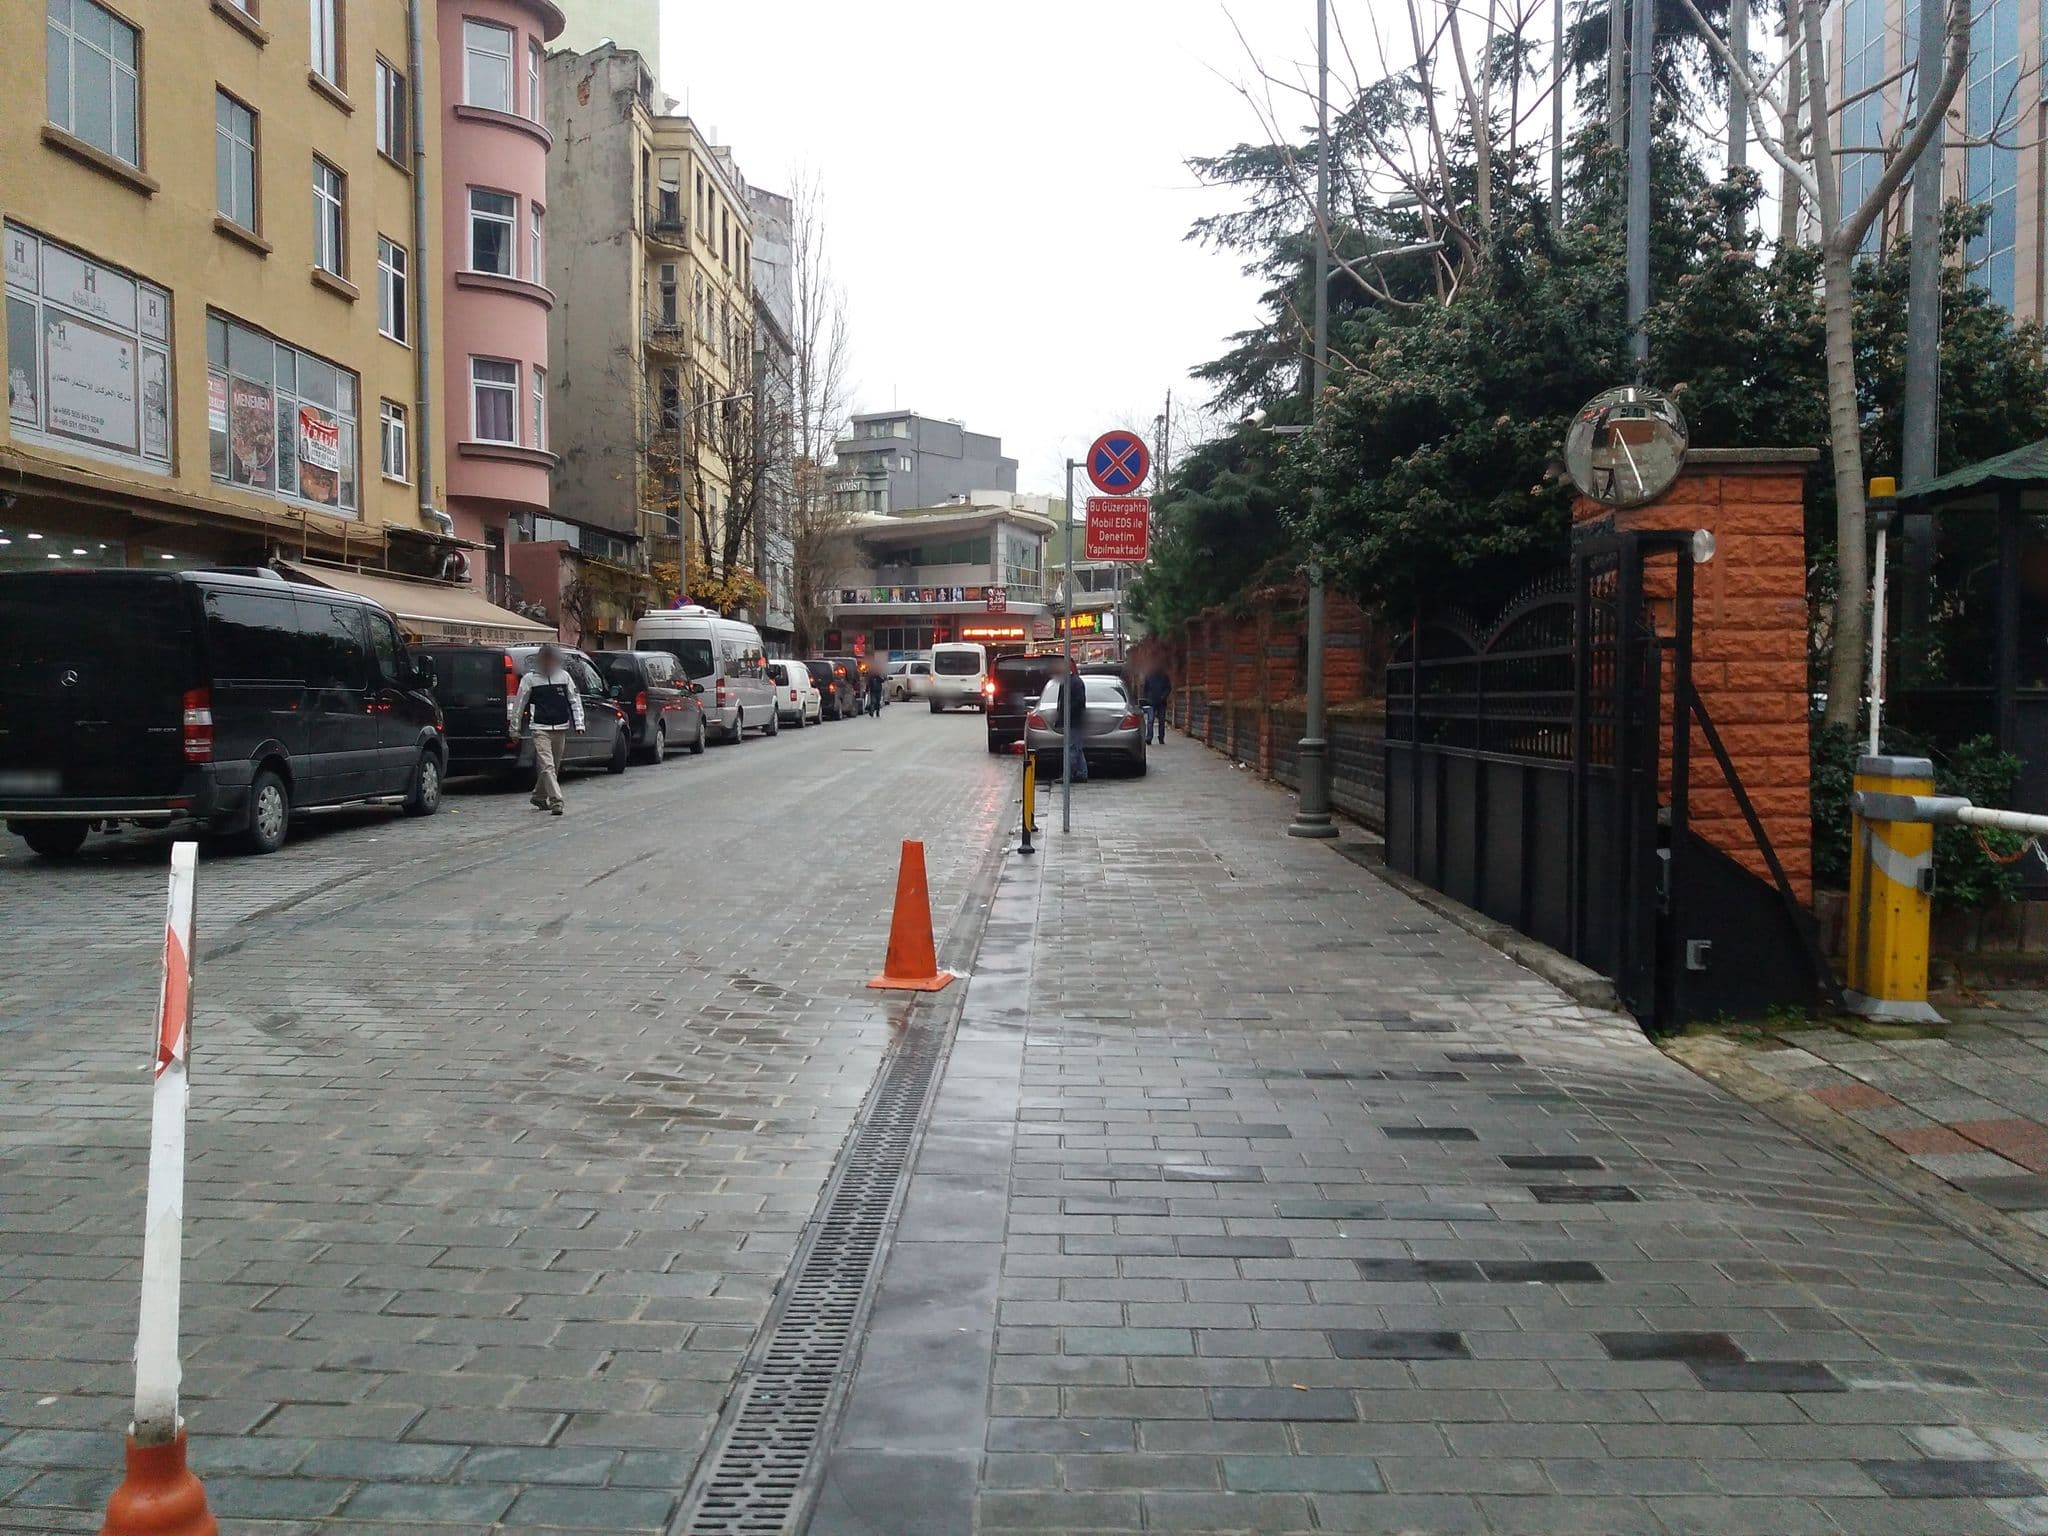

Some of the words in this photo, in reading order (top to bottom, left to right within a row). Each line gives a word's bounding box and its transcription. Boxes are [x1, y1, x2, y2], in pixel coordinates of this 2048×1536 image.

[14, 239, 25, 263] H
[83, 264, 97, 293] H
[148, 299, 157, 318] H
[233, 392, 270, 411] MENEMEN
[1089, 502, 1100, 513] Bu
[1101, 501, 1147, 515] Güzergahta
[1091, 517, 1114, 529] Mobil
[1115, 517, 1131, 529] EDS
[1133, 517, 1143, 529] ile
[1098, 530, 1135, 542] Denetim
[1087, 543, 1145, 557] Yapılmaktadır
